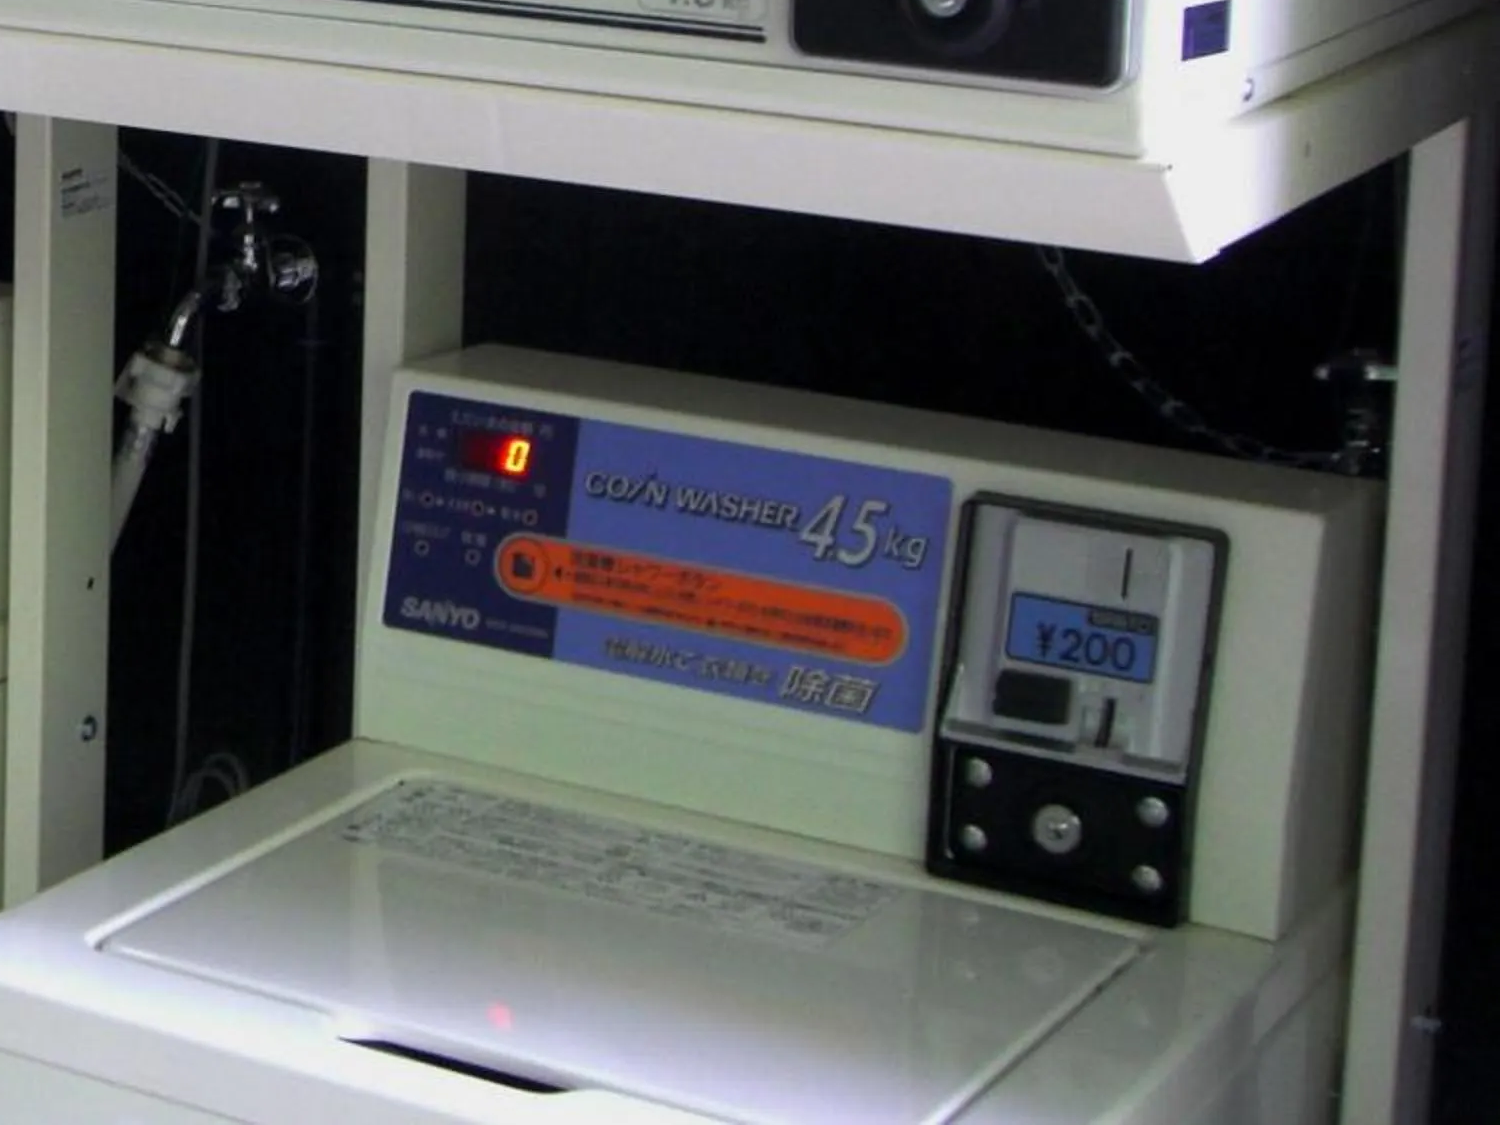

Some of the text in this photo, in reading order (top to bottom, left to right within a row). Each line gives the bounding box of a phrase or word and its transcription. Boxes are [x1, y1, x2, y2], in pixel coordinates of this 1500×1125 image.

[503, 439, 531, 473] 0
[585, 470, 668, 510] COIN
[676, 485, 799, 531] WASHER
[885, 523, 929, 569] kg
[400, 595, 481, 631] SANYO
[1036, 620, 1137, 673] ¥200
